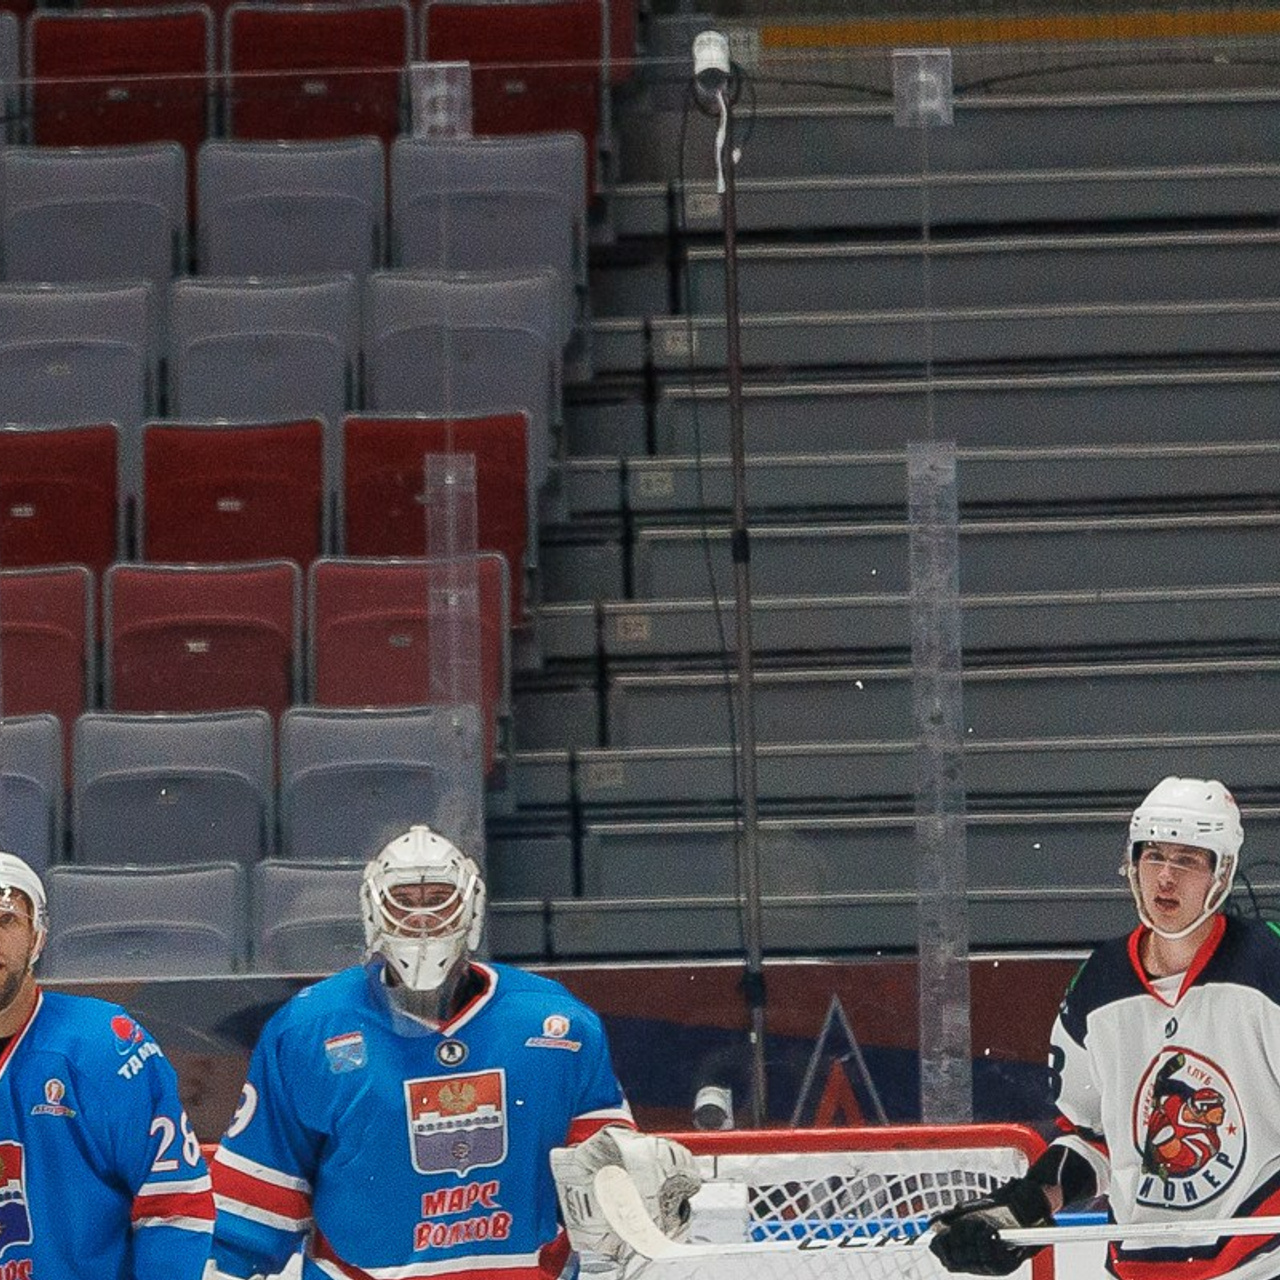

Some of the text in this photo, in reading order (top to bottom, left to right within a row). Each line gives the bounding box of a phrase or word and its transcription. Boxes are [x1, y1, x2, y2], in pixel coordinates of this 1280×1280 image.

[149, 1111, 201, 1173] 28
[421, 1180, 501, 1219] МАРС
[413, 1211, 513, 1252] ВОЛХОВ
